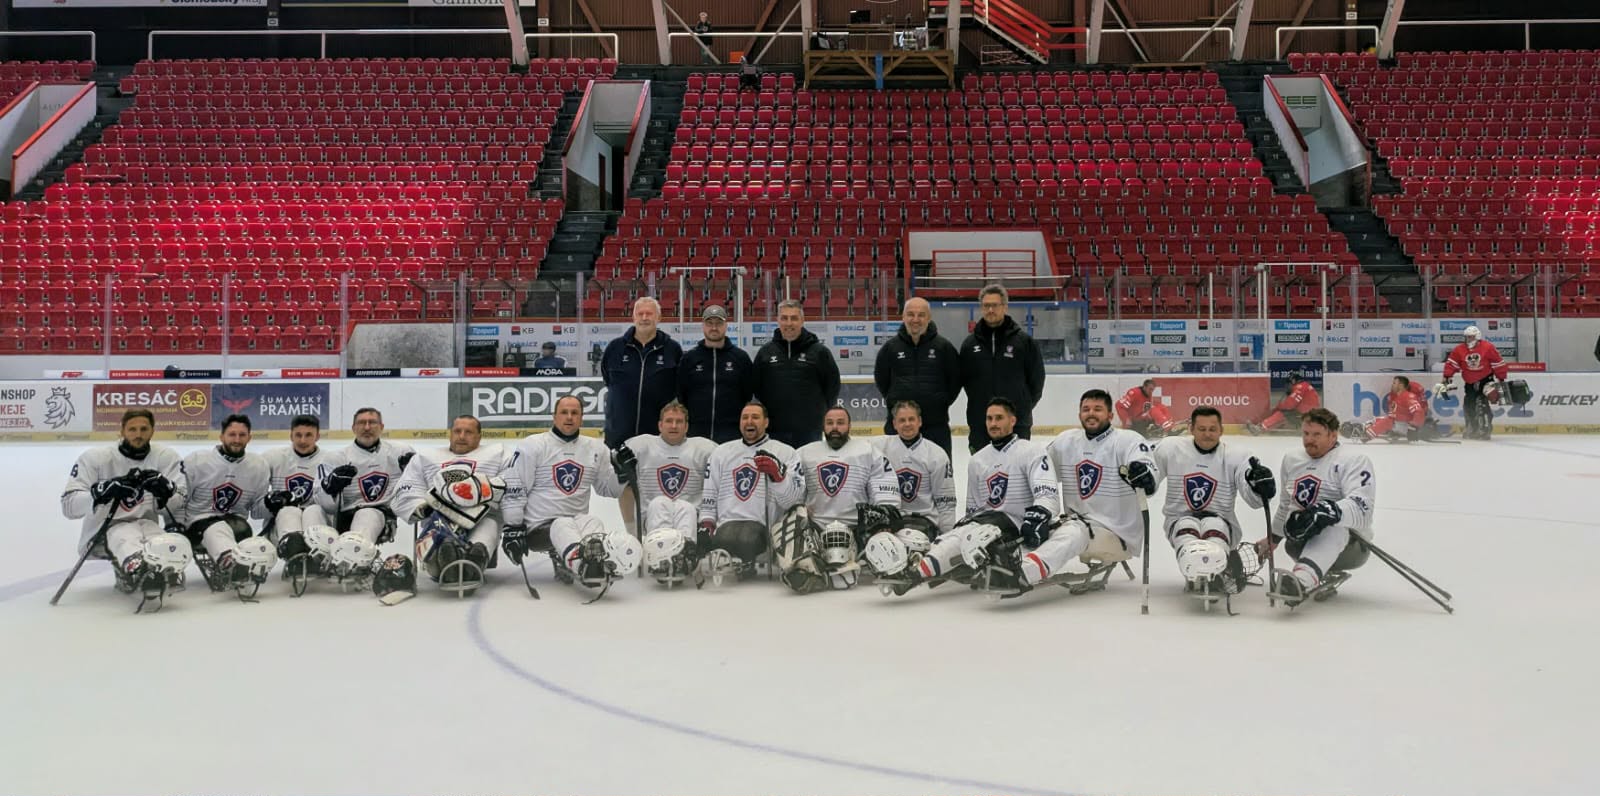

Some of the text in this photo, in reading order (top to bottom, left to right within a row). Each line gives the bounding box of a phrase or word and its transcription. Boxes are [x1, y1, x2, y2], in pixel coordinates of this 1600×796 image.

[535, 368, 564, 376] MORA
[1, 389, 36, 400] NSHOP
[96, 390, 177, 406] KRESÁČ
[260, 394, 322, 404] ŠUMAVSKÝ
[1188, 396, 1250, 406] OLOMOUC
[1539, 395, 1599, 406] HOCKEY
[259, 404, 321, 416] PRAMEN
